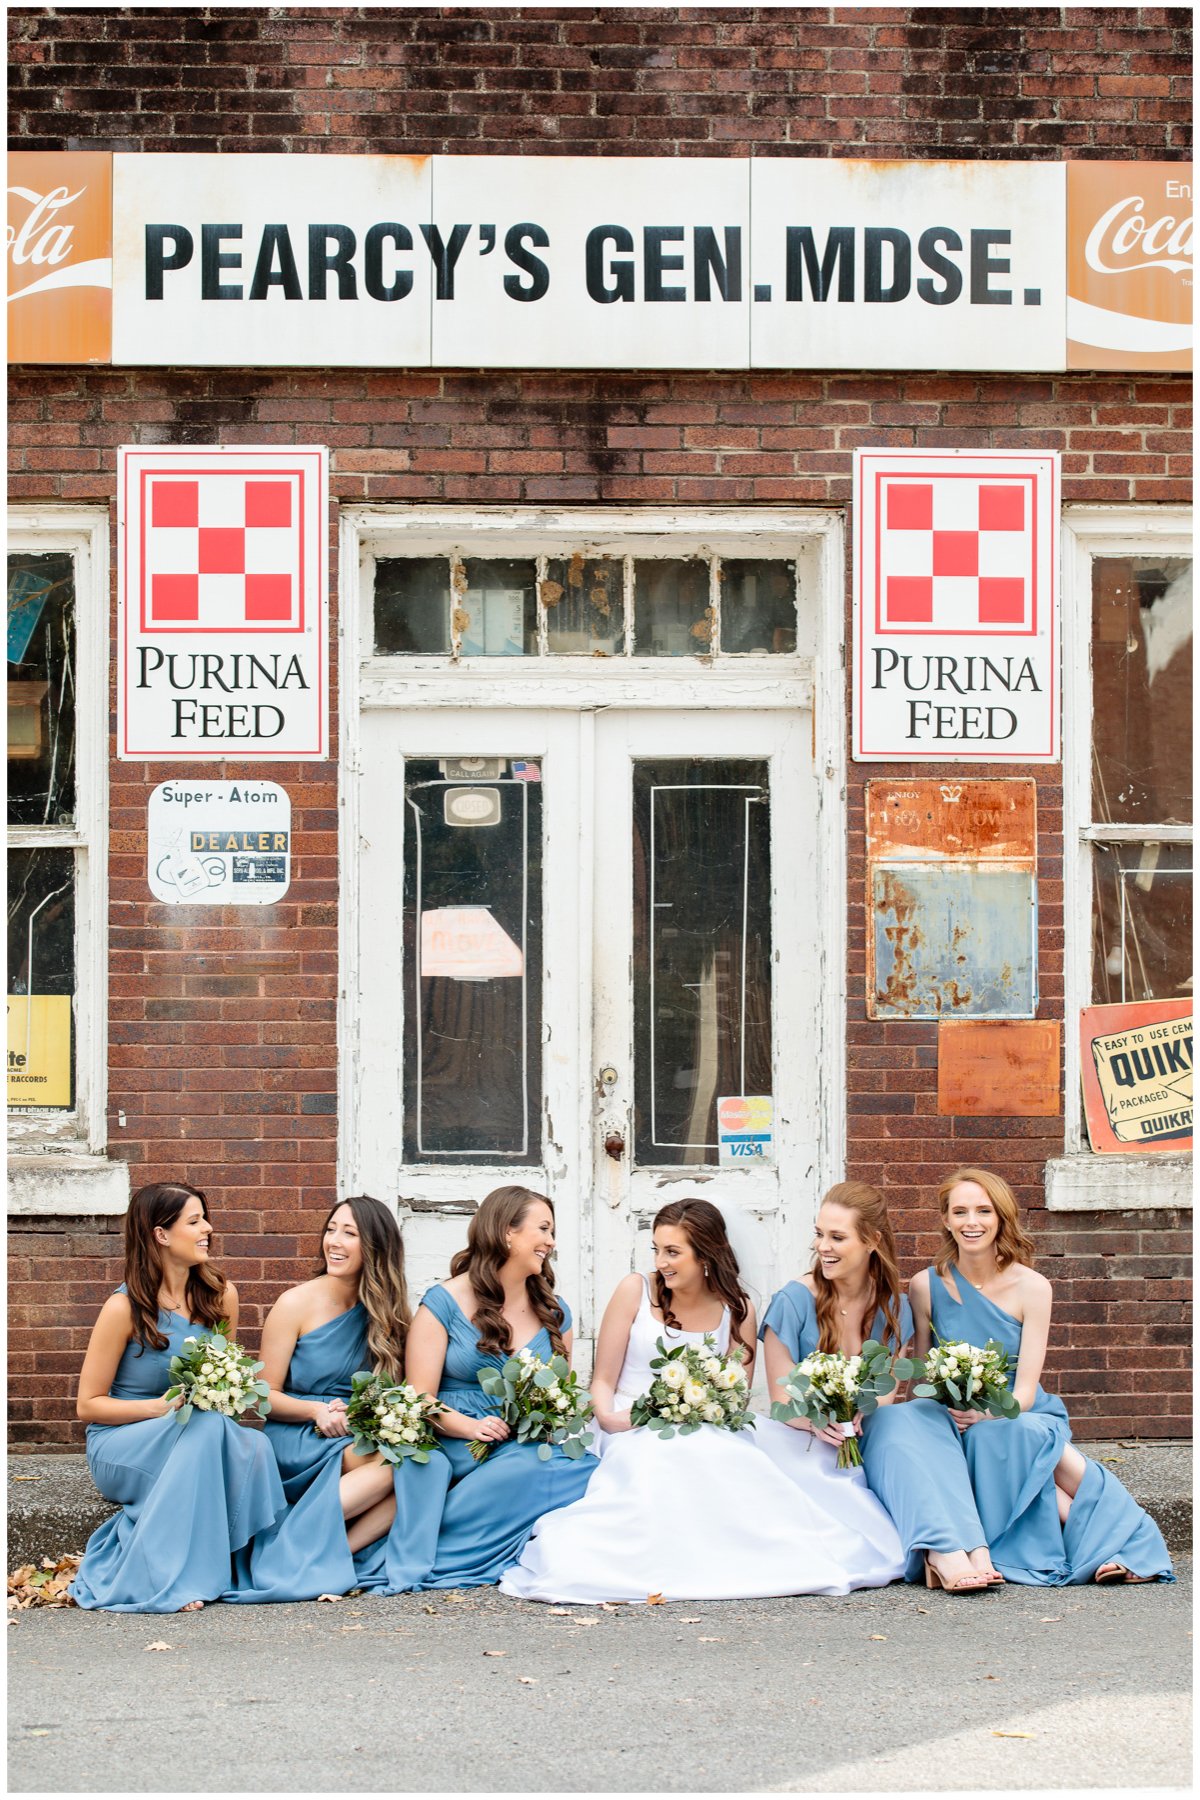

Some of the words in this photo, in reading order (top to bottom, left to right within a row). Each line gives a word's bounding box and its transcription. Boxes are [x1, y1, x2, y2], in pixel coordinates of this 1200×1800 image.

[144, 222, 550, 302] PEARCY'S
[585, 224, 772, 304] GEN.
[785, 226, 1042, 306] MDSE.
[135, 646, 311, 693] PURINA
[870, 648, 1043, 695] PURINA
[170, 699, 286, 738] FEED
[905, 700, 1018, 740] FEED
[162, 786, 213, 808] Super
[229, 787, 278, 803] Atom
[192, 833, 287, 850] DEALER
[1104, 1038, 1128, 1051] EASY
[1131, 1034, 1144, 1044] TO
[1151, 1027, 1169, 1040] USE
[11, 1075, 48, 1083] RACCORDS
[1119, 1090, 1169, 1110] PACKAGED
[1140, 1109, 1193, 1135] QUIKR
[731, 1143, 764, 1156] VISA
